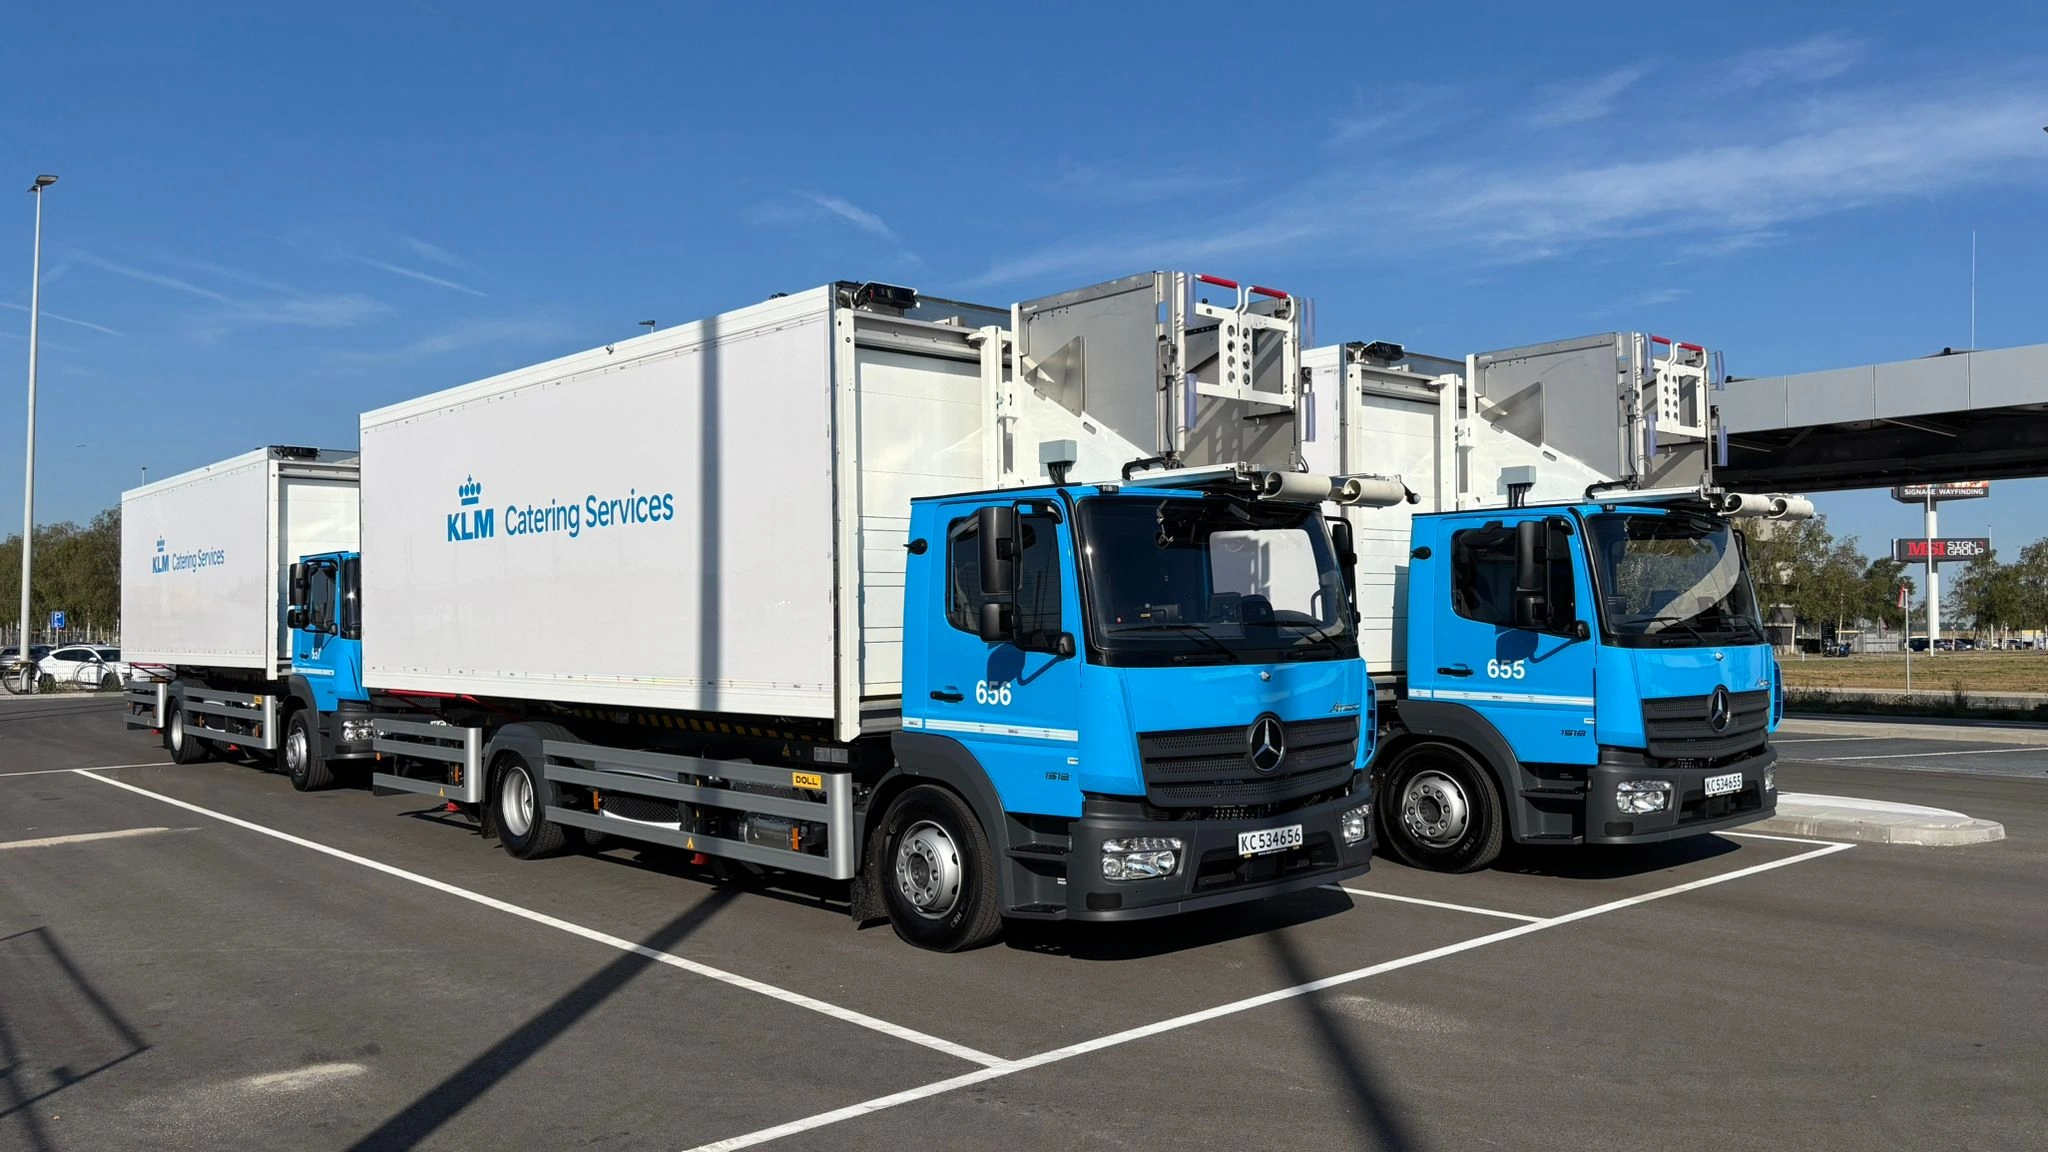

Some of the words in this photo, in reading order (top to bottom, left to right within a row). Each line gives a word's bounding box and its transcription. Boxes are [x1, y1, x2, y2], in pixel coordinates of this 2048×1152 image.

[447, 508, 494, 542] KLM
[505, 498, 580, 537] Catering
[585, 488, 674, 528] Services
[1907, 541, 1946, 556] MSI
[1947, 541, 1977, 549] SIGN
[1947, 548, 1984, 556] GROUP
[152, 554, 169, 574] KLM
[172, 550, 197, 573] Catering
[197, 546, 225, 567] Services
[54, 612, 62, 622] P
[1487, 658, 1525, 680] 655
[975, 679, 1012, 706] 656
[795, 775, 818, 786] DOLL
